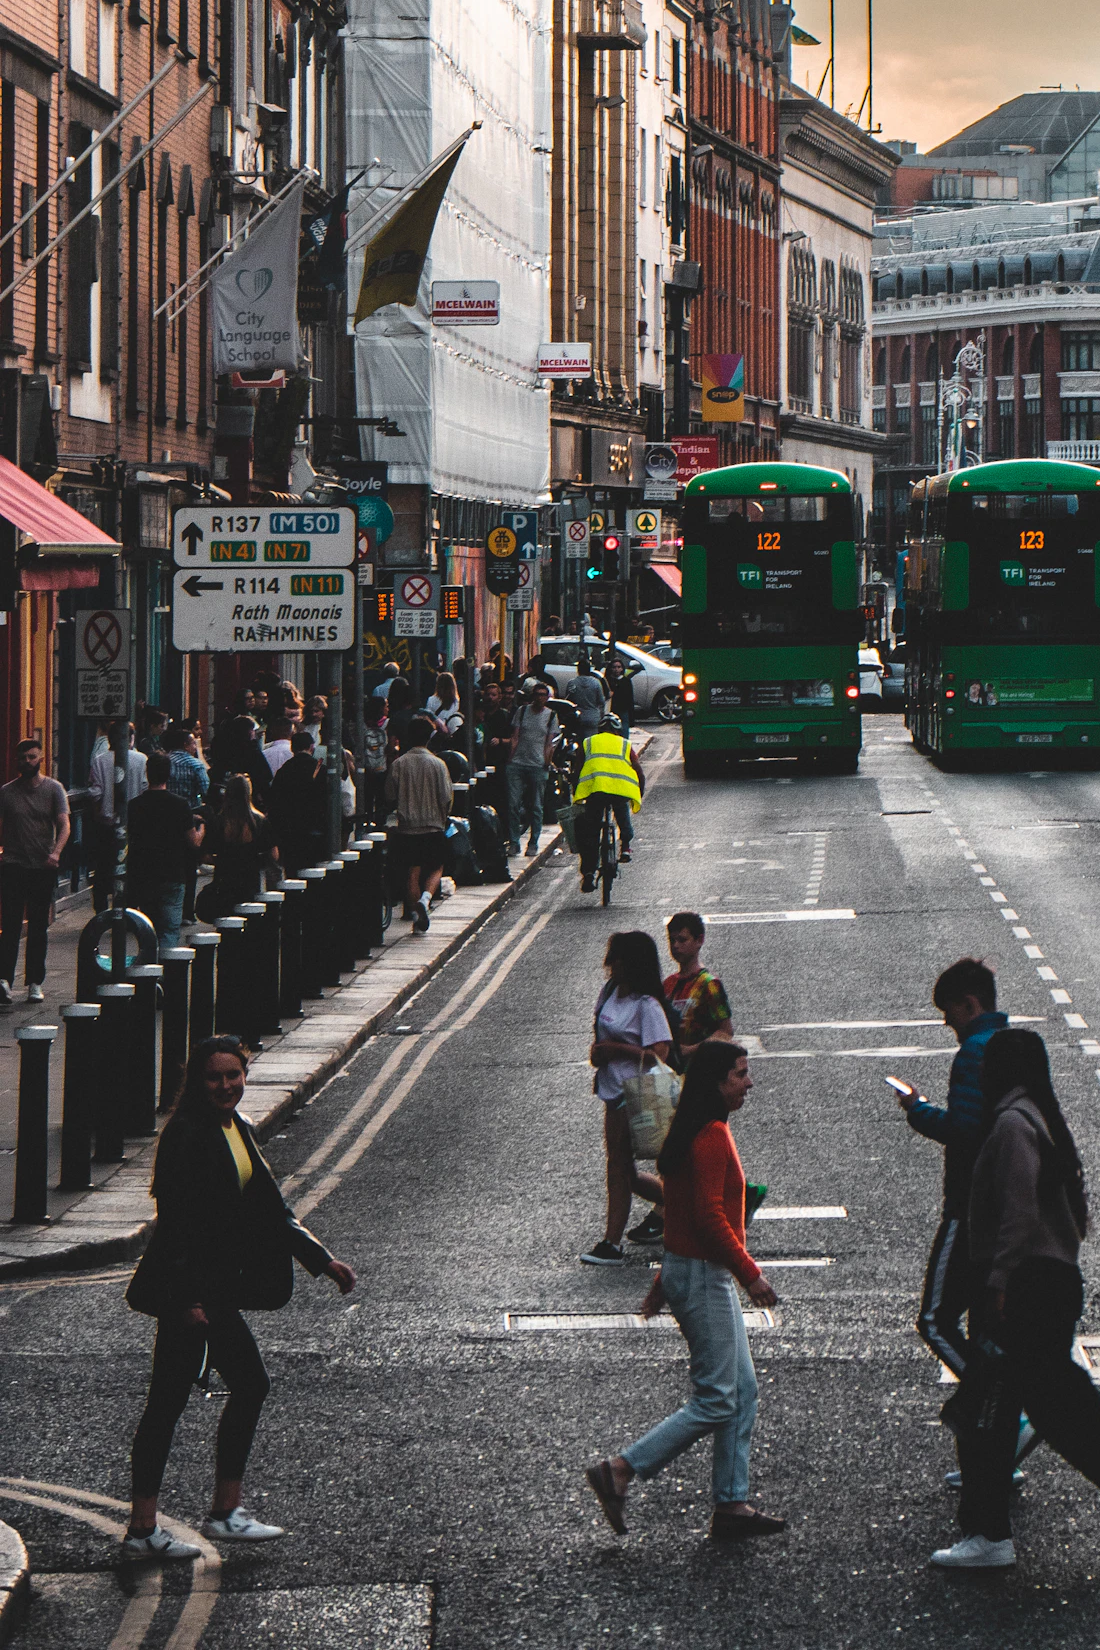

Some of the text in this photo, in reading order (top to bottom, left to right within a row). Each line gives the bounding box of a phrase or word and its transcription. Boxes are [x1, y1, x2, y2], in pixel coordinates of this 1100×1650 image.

[435, 300, 496, 309] MCELWAIN
[236, 311, 265, 328] City
[219, 328, 291, 344] Language
[228, 348, 275, 362] School
[540, 359, 588, 367] MCELWAIN
[677, 445, 711, 454] Indian
[648, 453, 674, 471] City
[690, 455, 699, 465] &
[757, 532, 781, 550] 122
[1020, 531, 1044, 549] 123
[740, 570, 760, 581] TFI
[1003, 568, 1023, 578] TFI
[232, 603, 342, 620] Ráth Maonais
